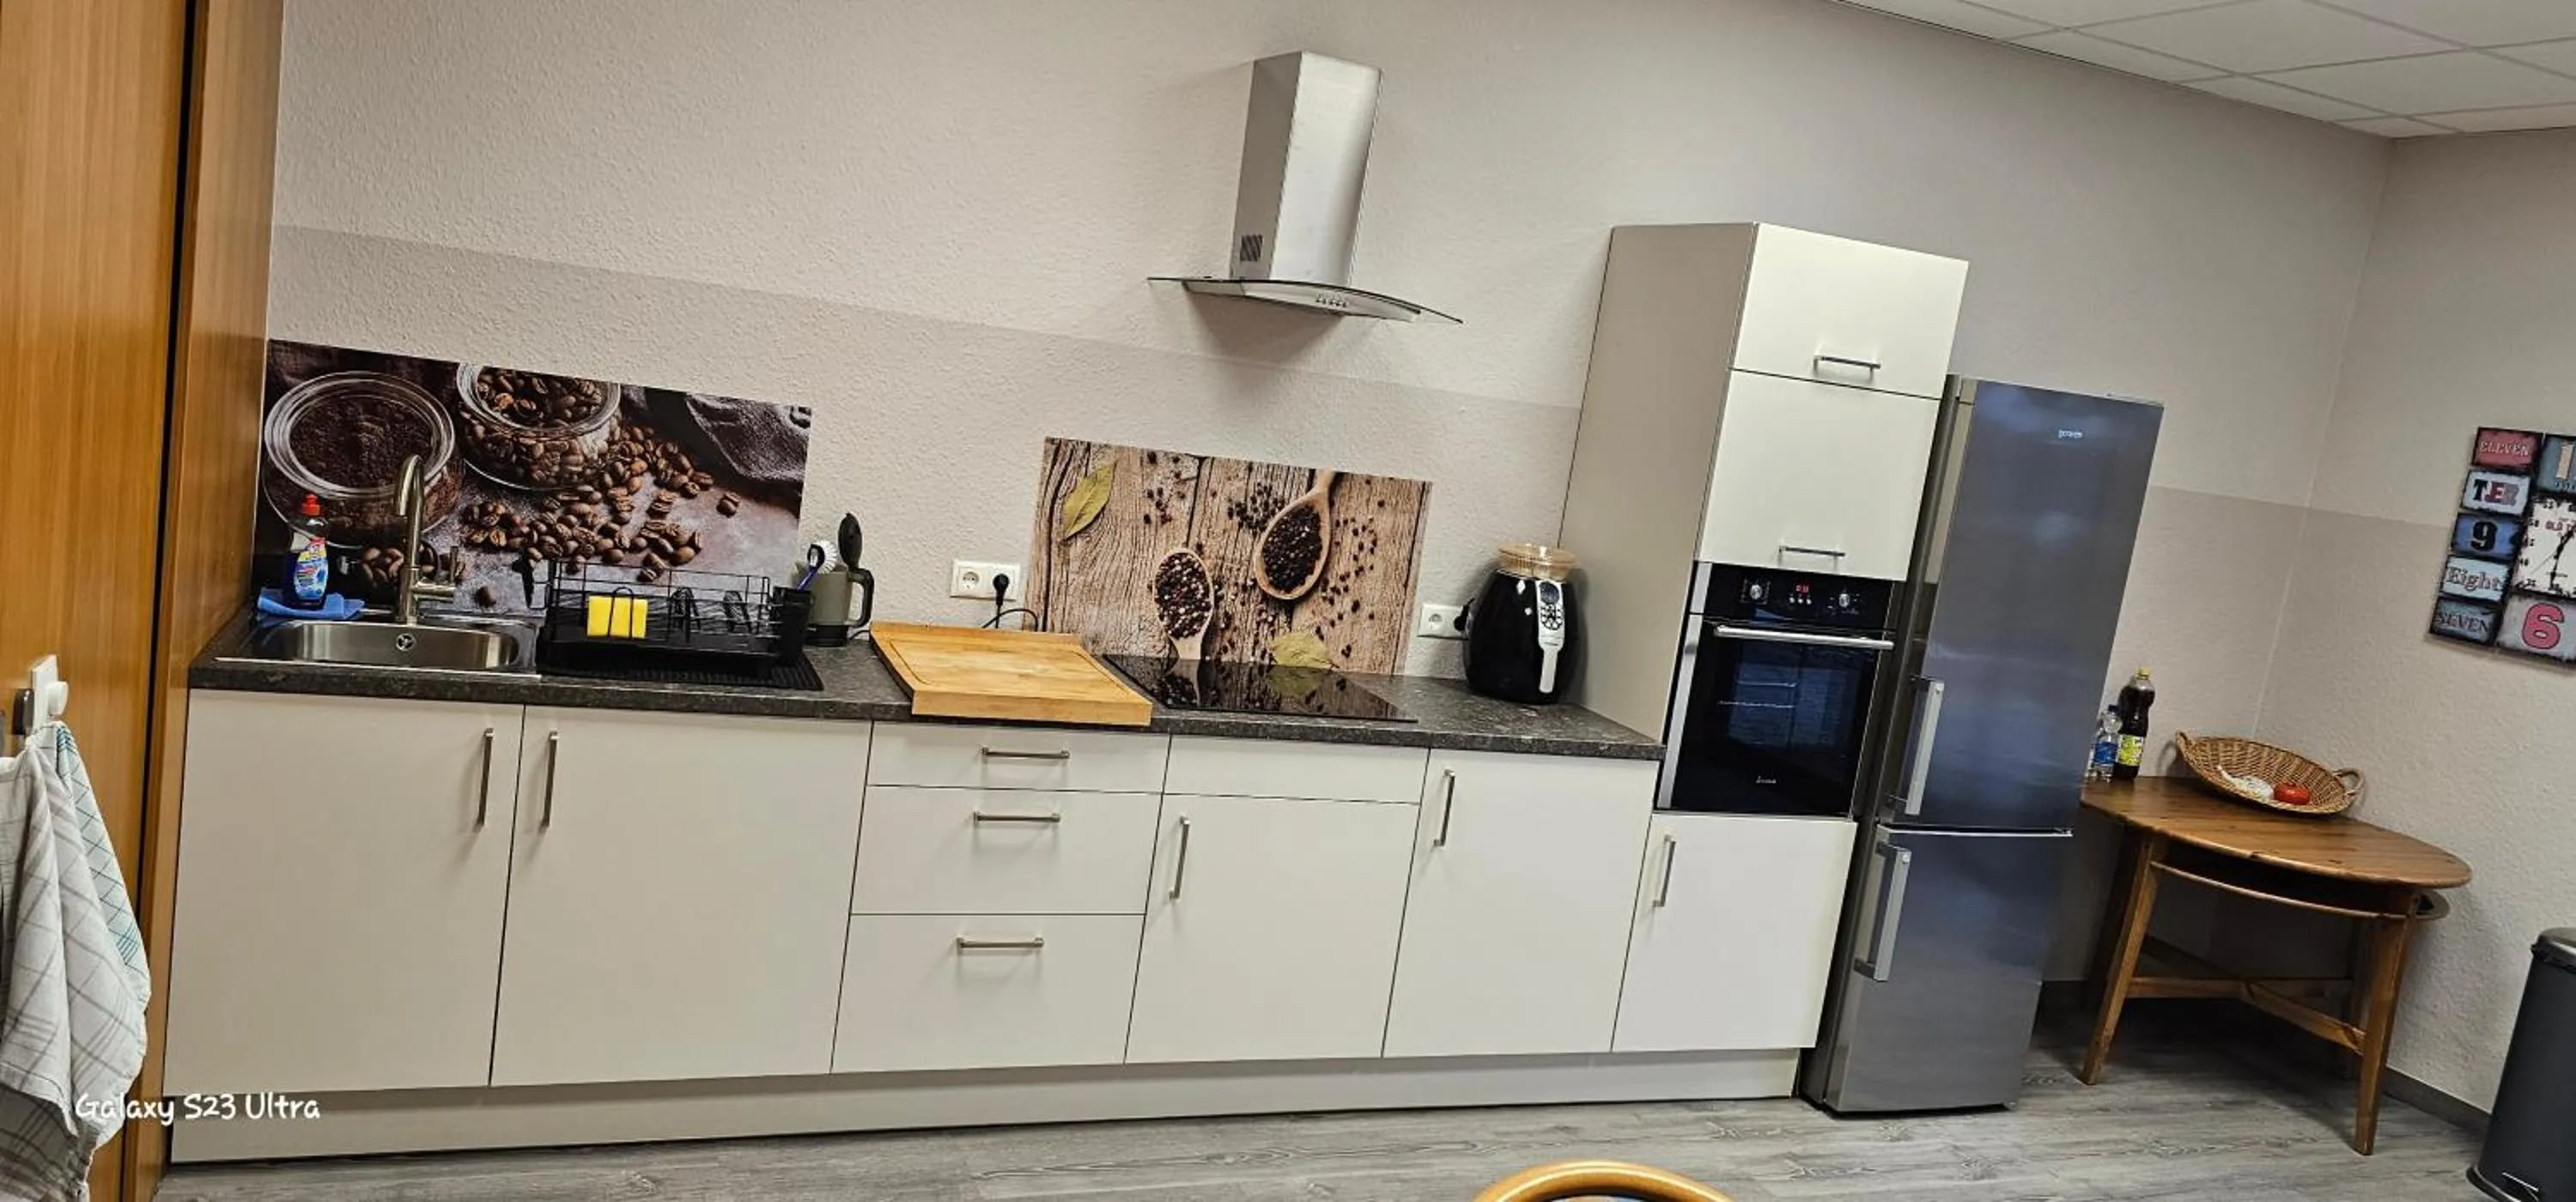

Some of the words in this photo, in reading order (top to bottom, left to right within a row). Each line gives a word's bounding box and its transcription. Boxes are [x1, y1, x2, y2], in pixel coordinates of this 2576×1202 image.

[2479, 440, 2529, 456] ELEVEN
[2470, 520, 2497, 550] 9
[2445, 567, 2503, 591] Eight
[2436, 611, 2490, 633] SEVEN
[2521, 603, 2565, 649] 6
